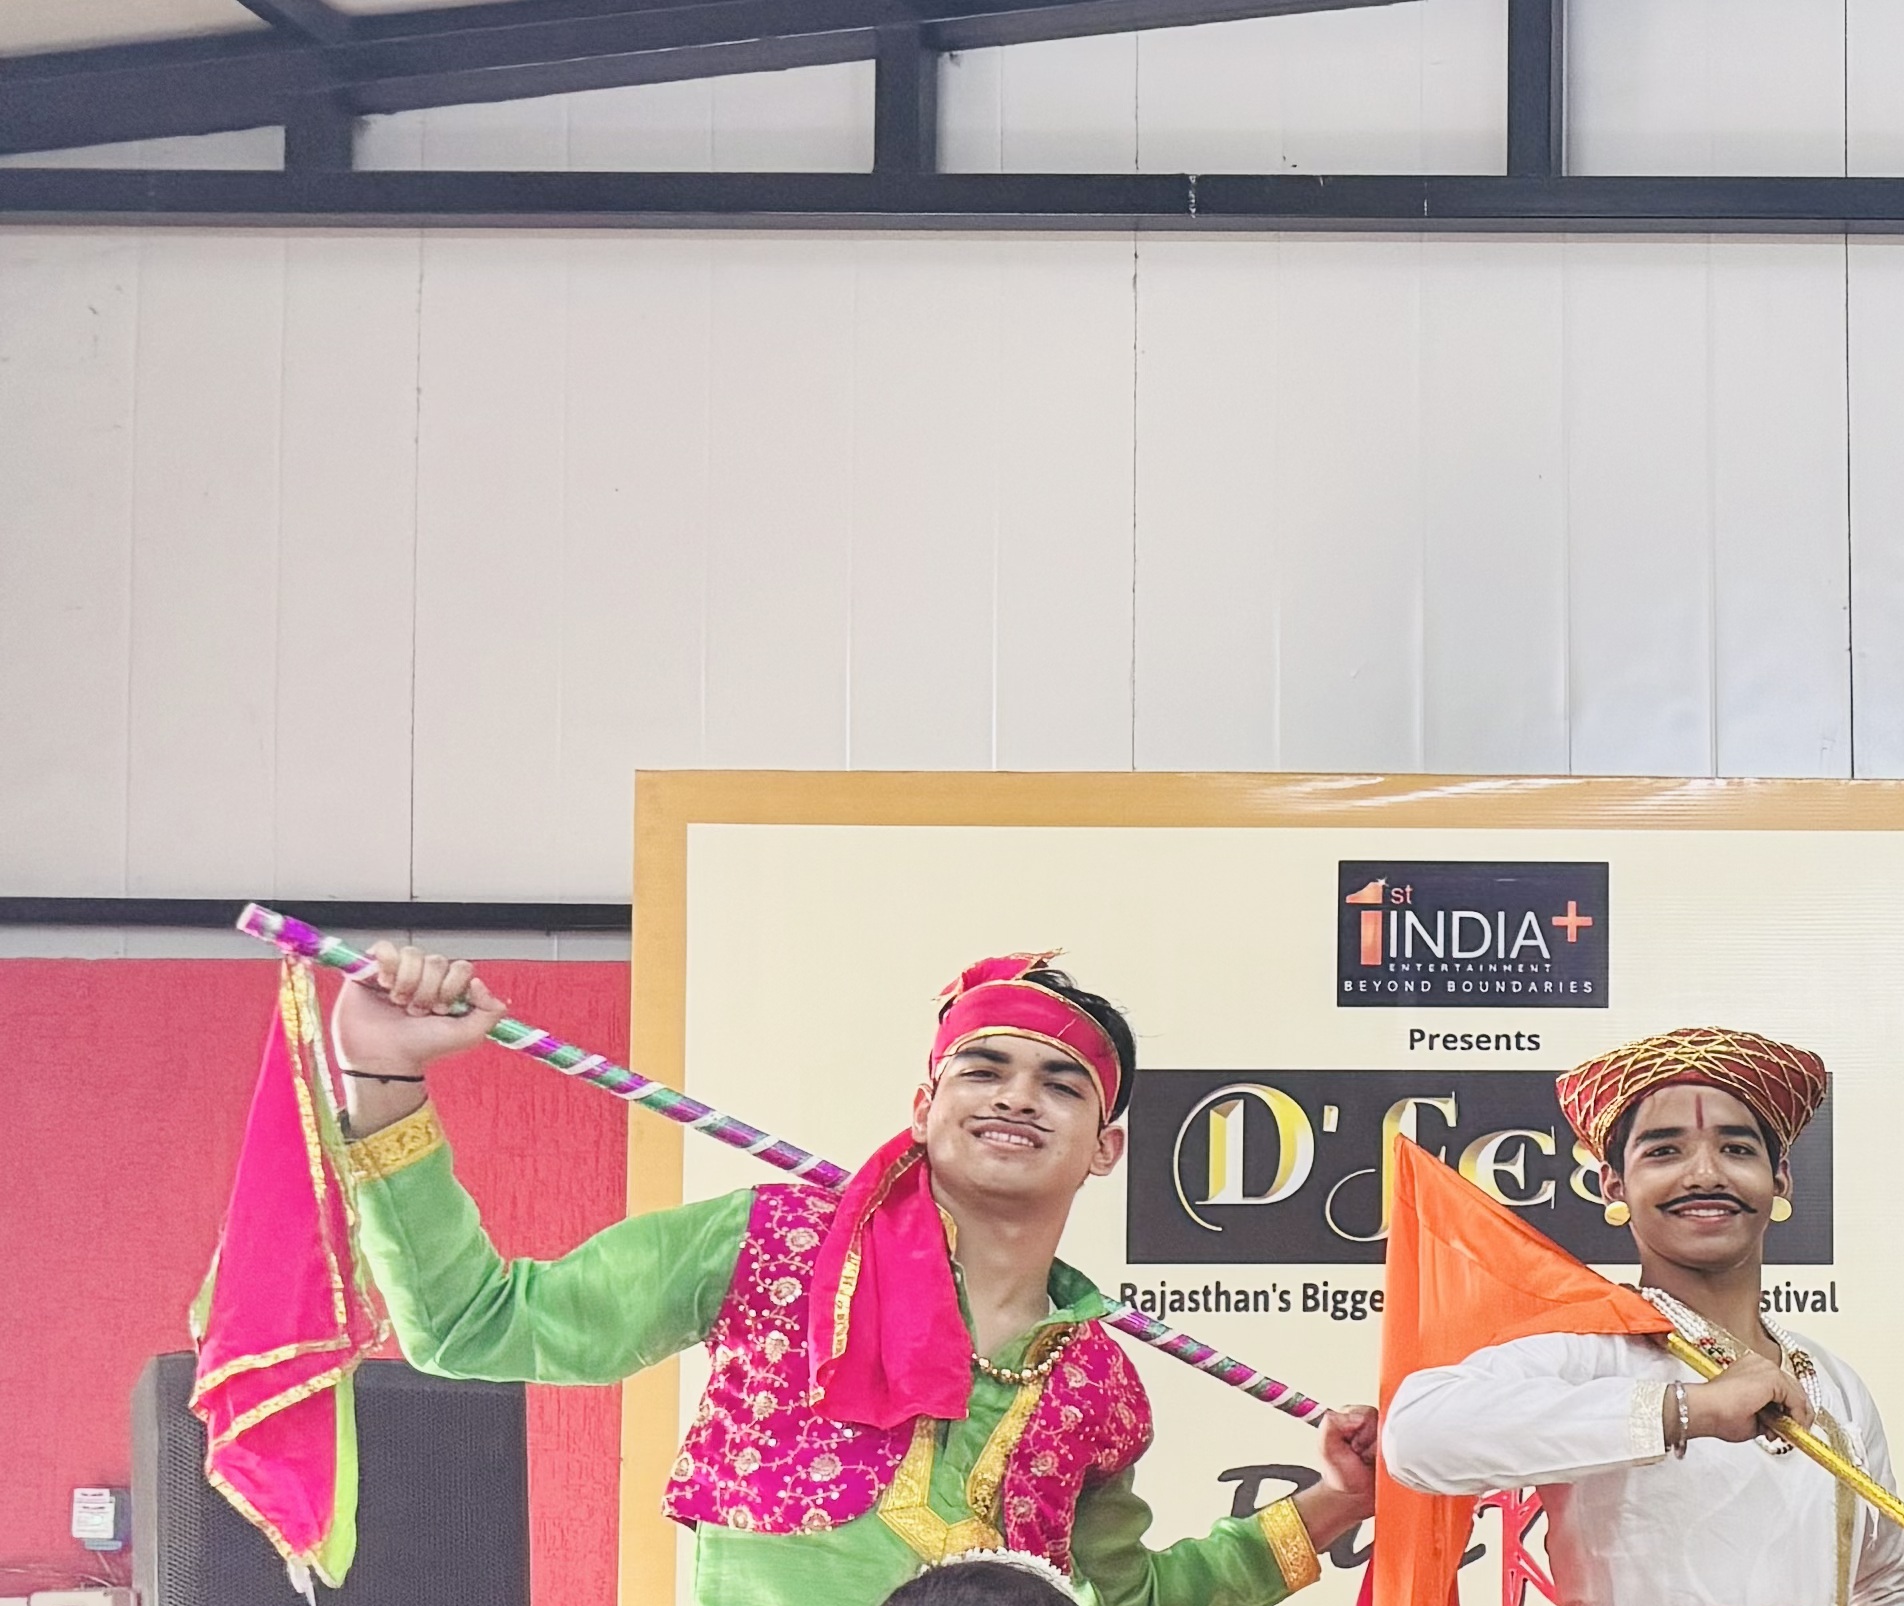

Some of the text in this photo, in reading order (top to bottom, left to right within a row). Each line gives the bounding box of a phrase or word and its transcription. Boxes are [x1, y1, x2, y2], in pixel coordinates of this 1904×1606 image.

[1388, 962, 1553, 973] ENTERTAINMENT
[1343, 980, 1594, 994] BEYOND BOUNDARIES
[1408, 1028, 1541, 1051] Presents
[1119, 1280, 1840, 1321] Rajasthan's Bigge stival
